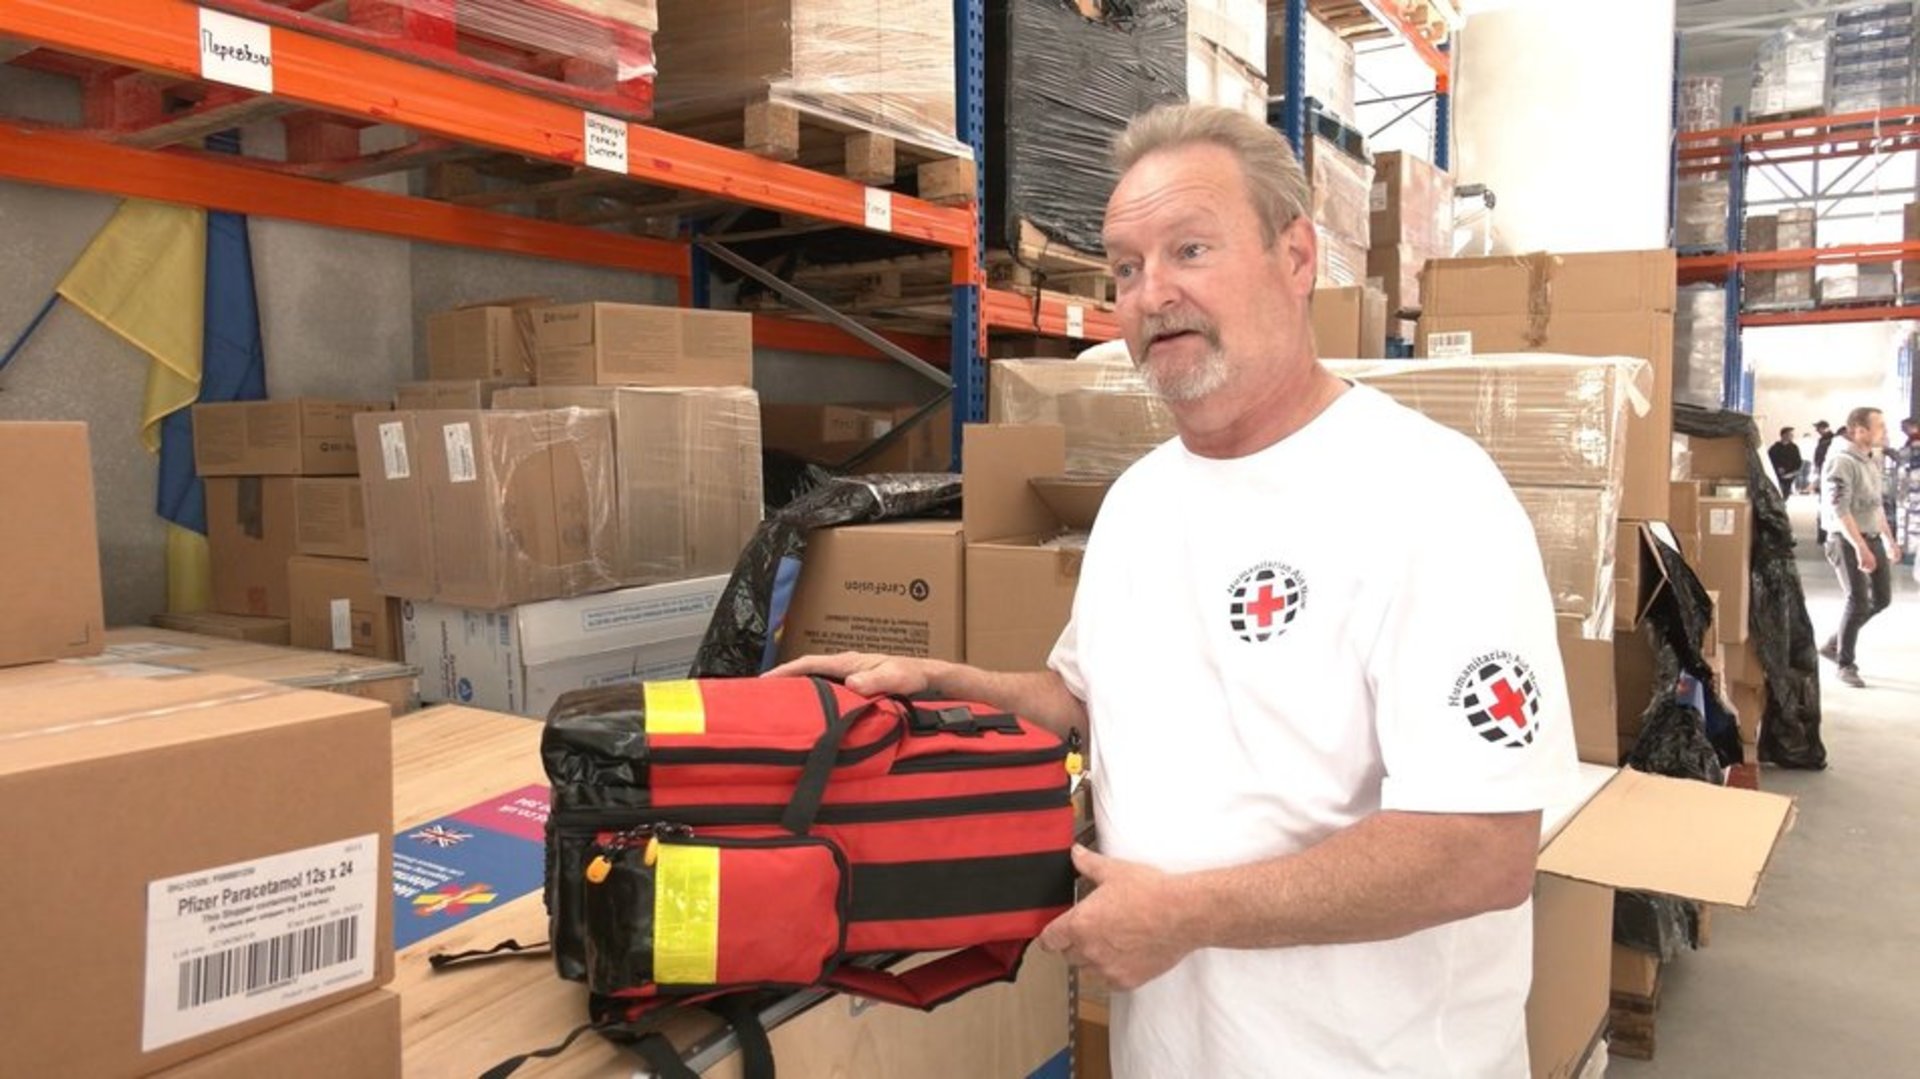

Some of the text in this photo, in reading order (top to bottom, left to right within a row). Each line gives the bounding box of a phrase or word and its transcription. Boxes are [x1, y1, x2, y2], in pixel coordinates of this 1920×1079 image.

[844, 580, 906, 597] CareFusion
[1227, 560, 1291, 593] Humanitarian
[178, 894, 222, 916] Pfizer
[222, 873, 302, 906] Paracetamol
[305, 868, 326, 886] 12s
[329, 867, 336, 880] x
[340, 860, 353, 877] 24
